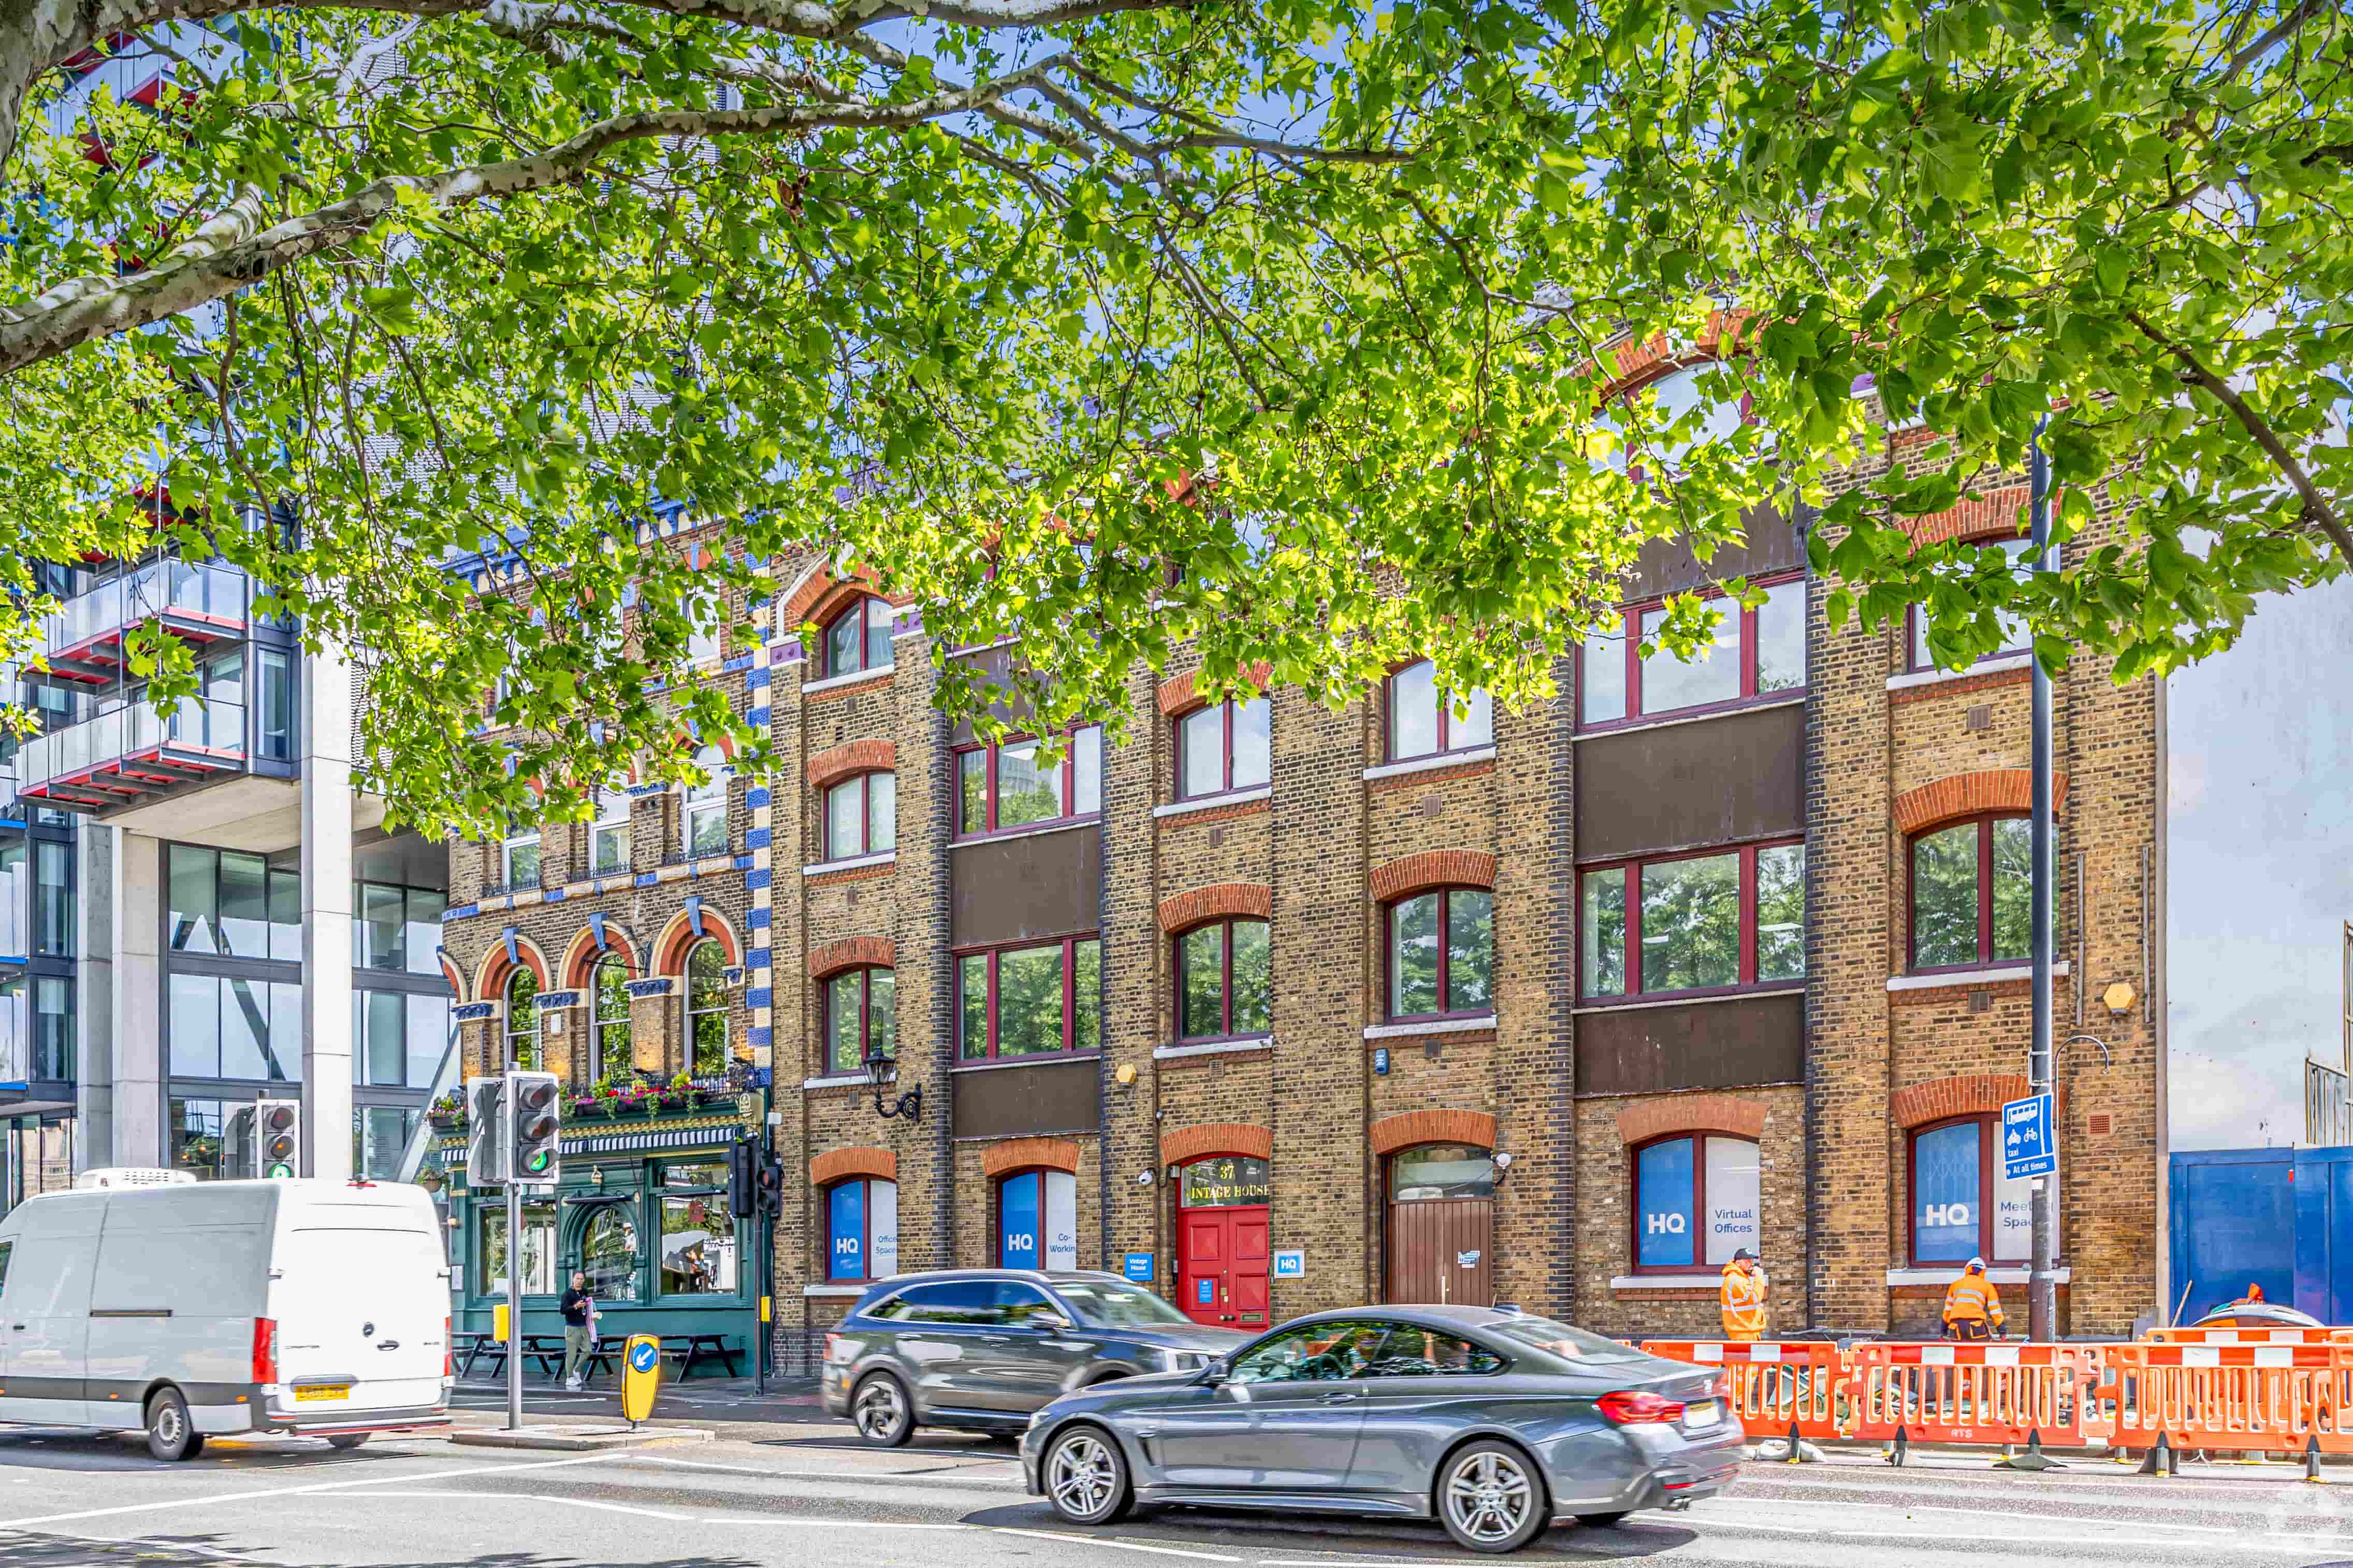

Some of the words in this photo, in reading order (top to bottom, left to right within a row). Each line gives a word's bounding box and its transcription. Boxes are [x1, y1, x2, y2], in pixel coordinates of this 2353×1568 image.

[1220, 1165, 1234, 1179] 37
[2013, 1165, 2021, 1174] At
[2030, 1162, 2047, 1171] times
[1715, 1209, 1752, 1219] Virtual
[1926, 1204, 1969, 1226] HQ
[1649, 1214, 1685, 1234] HQ
[1715, 1223, 1752, 1233] Offices
[836, 1238, 858, 1254] HQ
[1008, 1234, 1033, 1251] HQ
[1281, 1259, 1297, 1269] HQ
